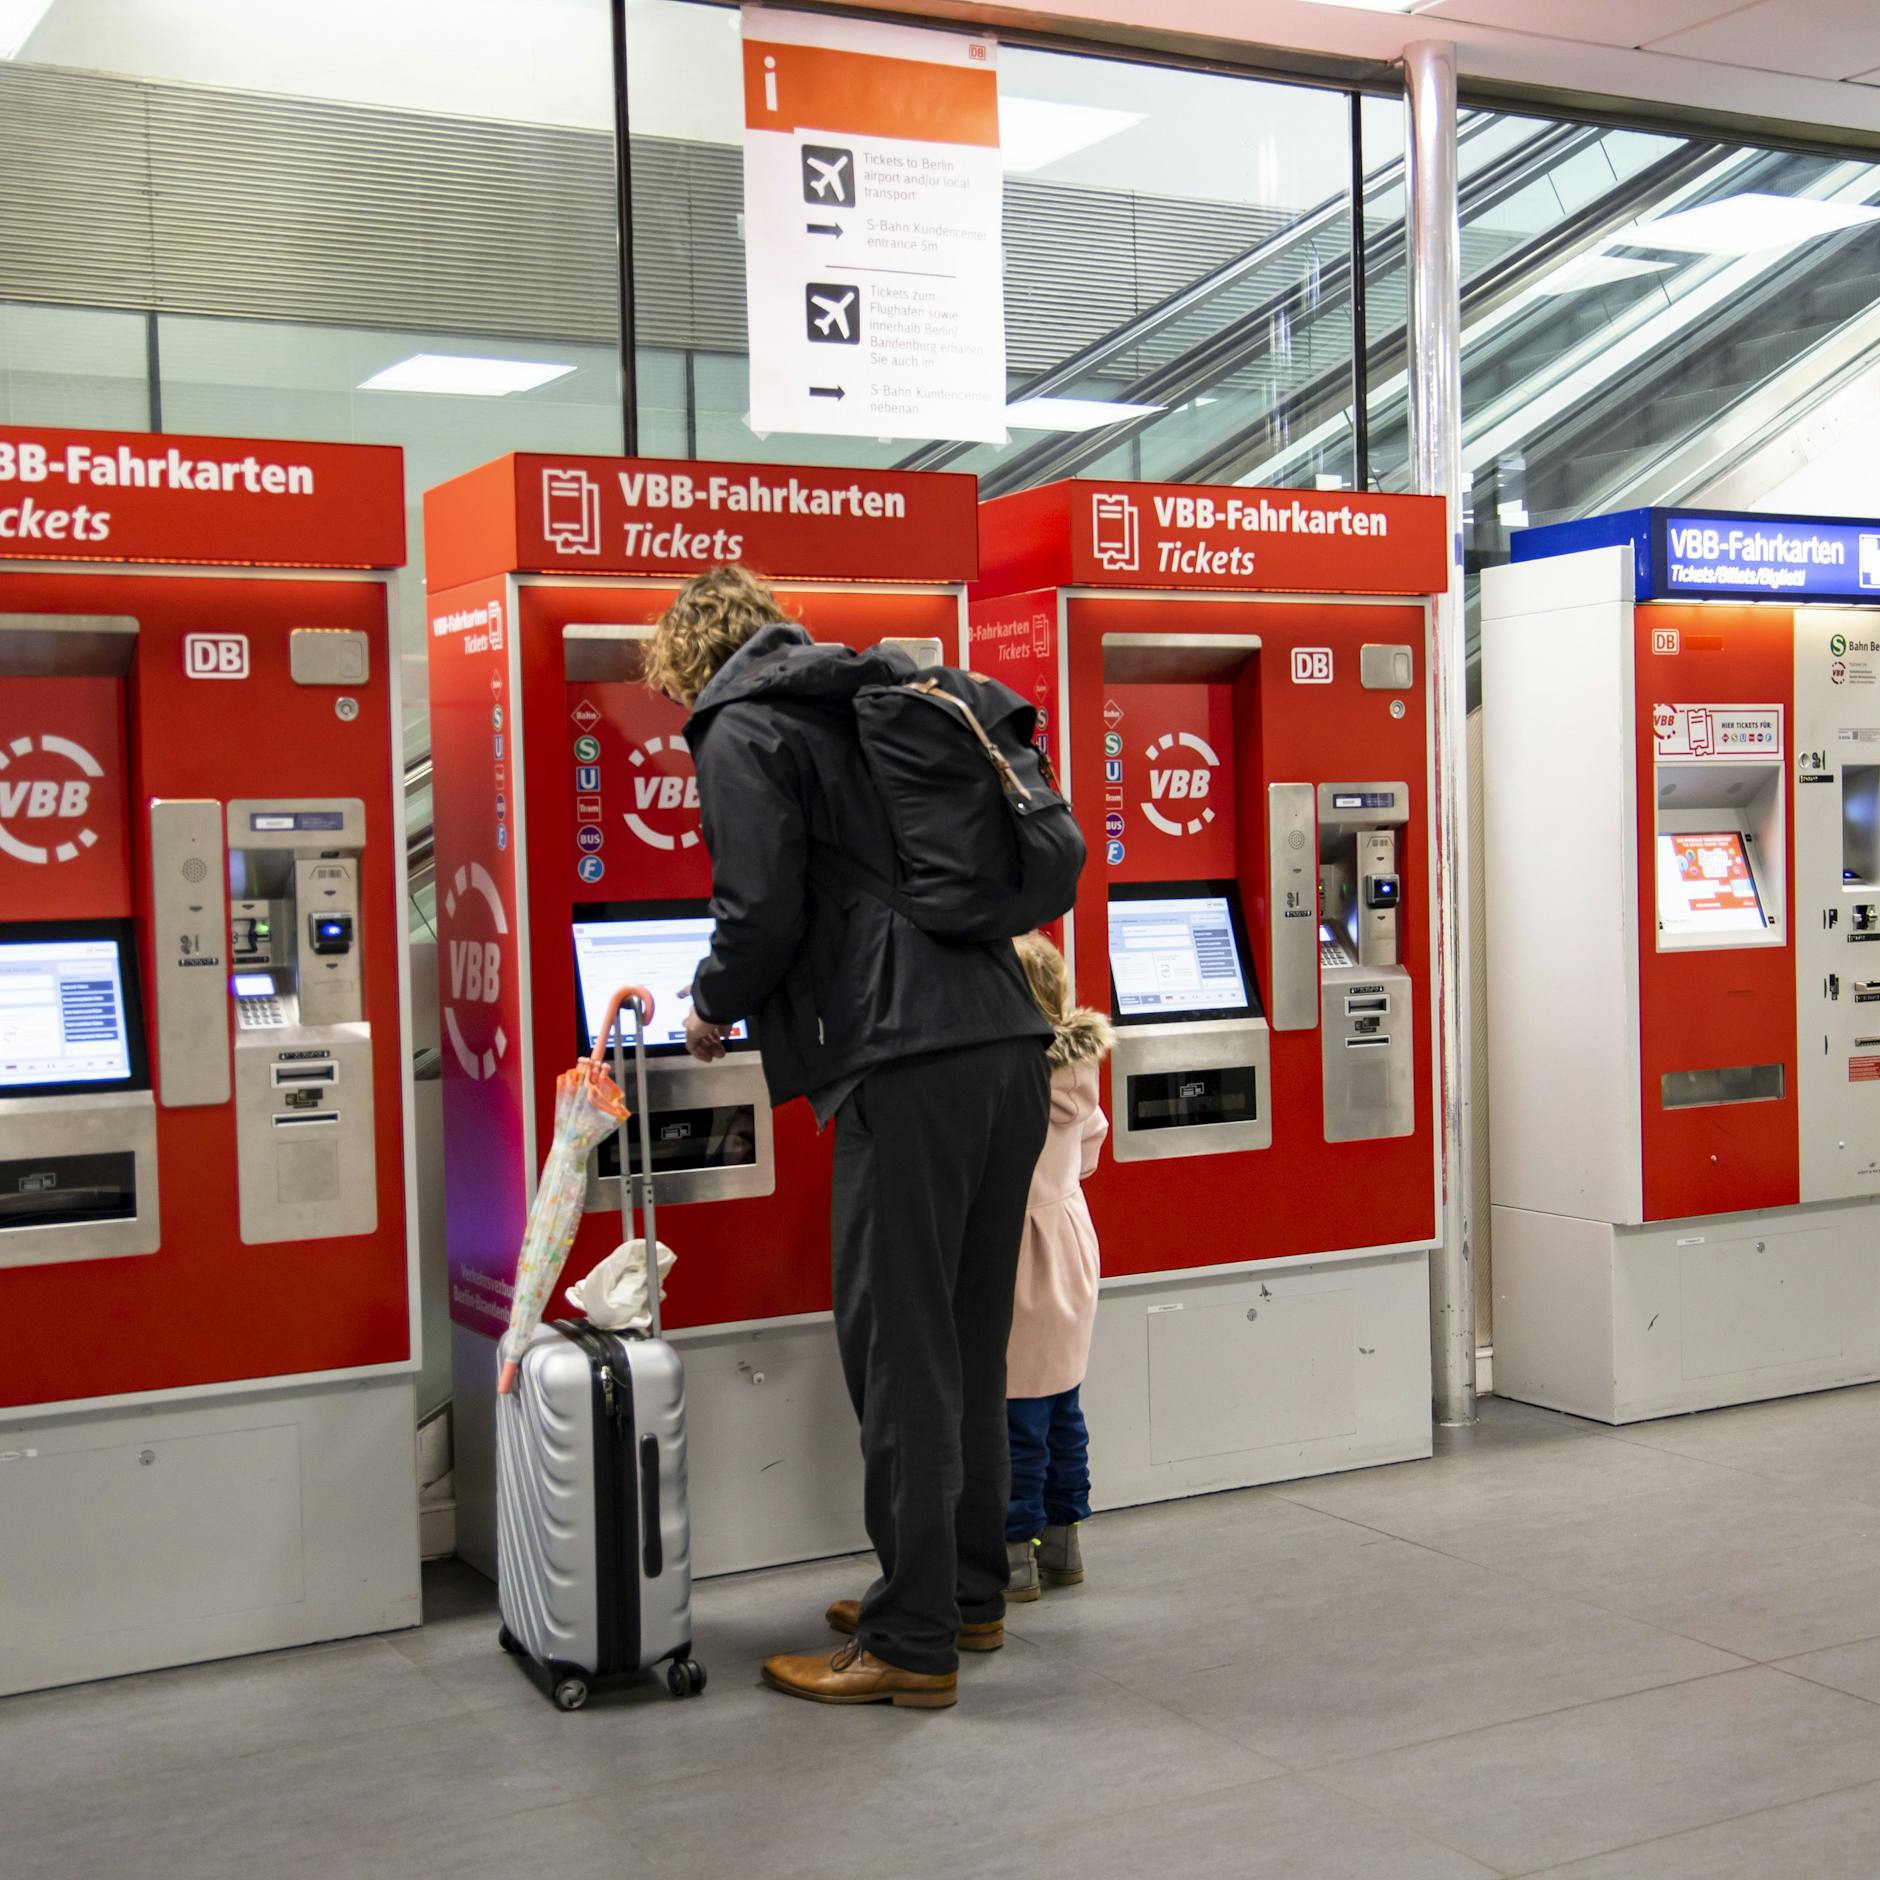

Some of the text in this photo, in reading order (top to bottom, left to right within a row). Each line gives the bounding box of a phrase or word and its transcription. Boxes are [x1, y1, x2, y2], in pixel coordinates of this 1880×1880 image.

[970, 46, 985, 58] DB
[864, 152, 954, 171] Tickets to Berlin
[864, 171, 900, 184] airport
[904, 174, 940, 187] and/or
[864, 187, 915, 201] transport
[866, 218, 909, 232] S-Bahn
[867, 237, 938, 252] entrance 5m
[870, 285, 936, 301] Tickets zum
[870, 302, 959, 321] Flughafen sowie
[869, 320, 921, 334] innerhalb
[870, 352, 935, 368] Sie auch im
[870, 403, 919, 415] nebenan
[0, 442, 314, 495] BB-Fahrkarten
[619, 472, 906, 519] VBB-Fahrkarten
[0, 497, 111, 541] ckets
[1154, 496, 1388, 537] VBB-Fahrkarten
[623, 523, 743, 561] Tickets
[1670, 528, 1845, 565] VBB-Fahrkarten
[1157, 541, 1255, 576] Tickets
[969, 621, 1029, 643] B-Fahrkarten
[1656, 633, 1676, 651] DB
[1849, 641, 1868, 651] Bahn
[1870, 641, 1880, 651] Be
[193, 640, 243, 672] DB
[998, 642, 1030, 662] Tickets
[1296, 653, 1329, 679] DB
[576, 711, 596, 720] Bahn
[1654, 715, 1675, 726] VBB
[578, 738, 596, 760] S
[1105, 735, 1119, 754] S
[580, 769, 596, 789] U
[1106, 762, 1119, 781] U
[1150, 769, 1211, 799] VBB
[1106, 821, 1123, 830] BUS
[580, 833, 600, 845] BUS
[450, 940, 501, 1004] VBB
